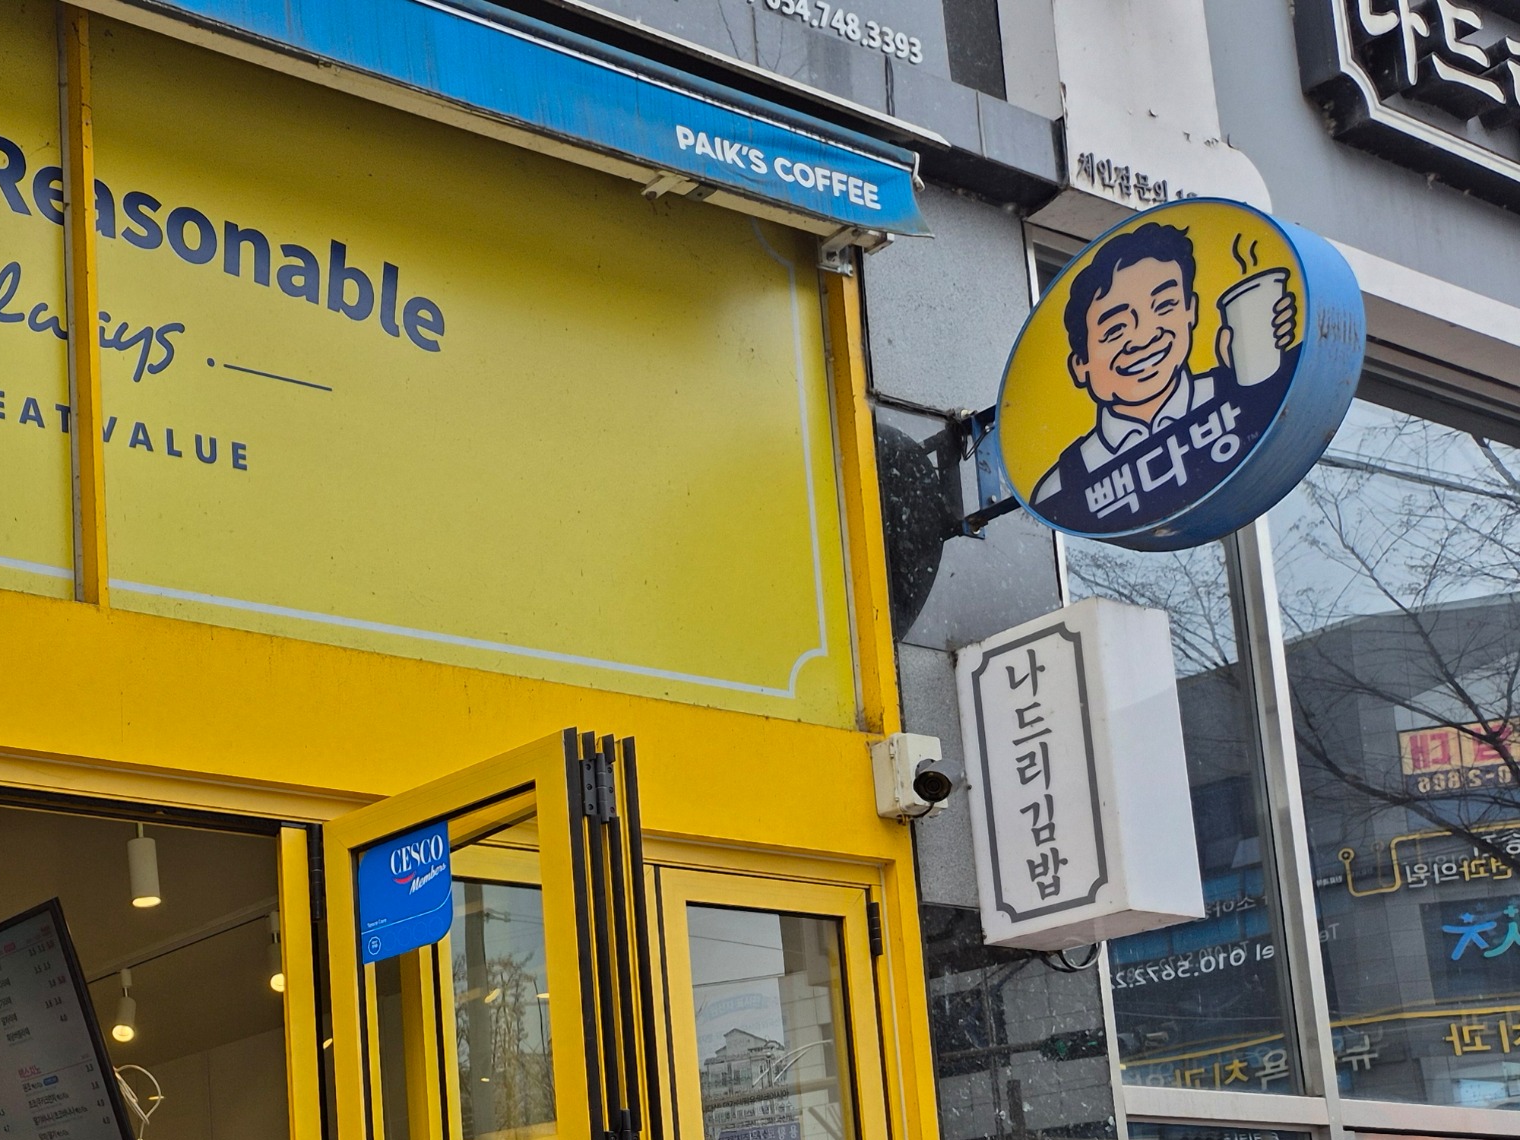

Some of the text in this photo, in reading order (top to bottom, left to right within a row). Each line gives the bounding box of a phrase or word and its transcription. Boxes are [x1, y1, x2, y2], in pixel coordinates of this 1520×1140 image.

[1358, 0, 1520, 106] 나드
[676, 125, 881, 210] PAIK'S COFFEE
[1085, 401, 1241, 519] 빽다방
[1005, 649, 1068, 900] 나드리김밥
[390, 834, 444, 876] CESCO
